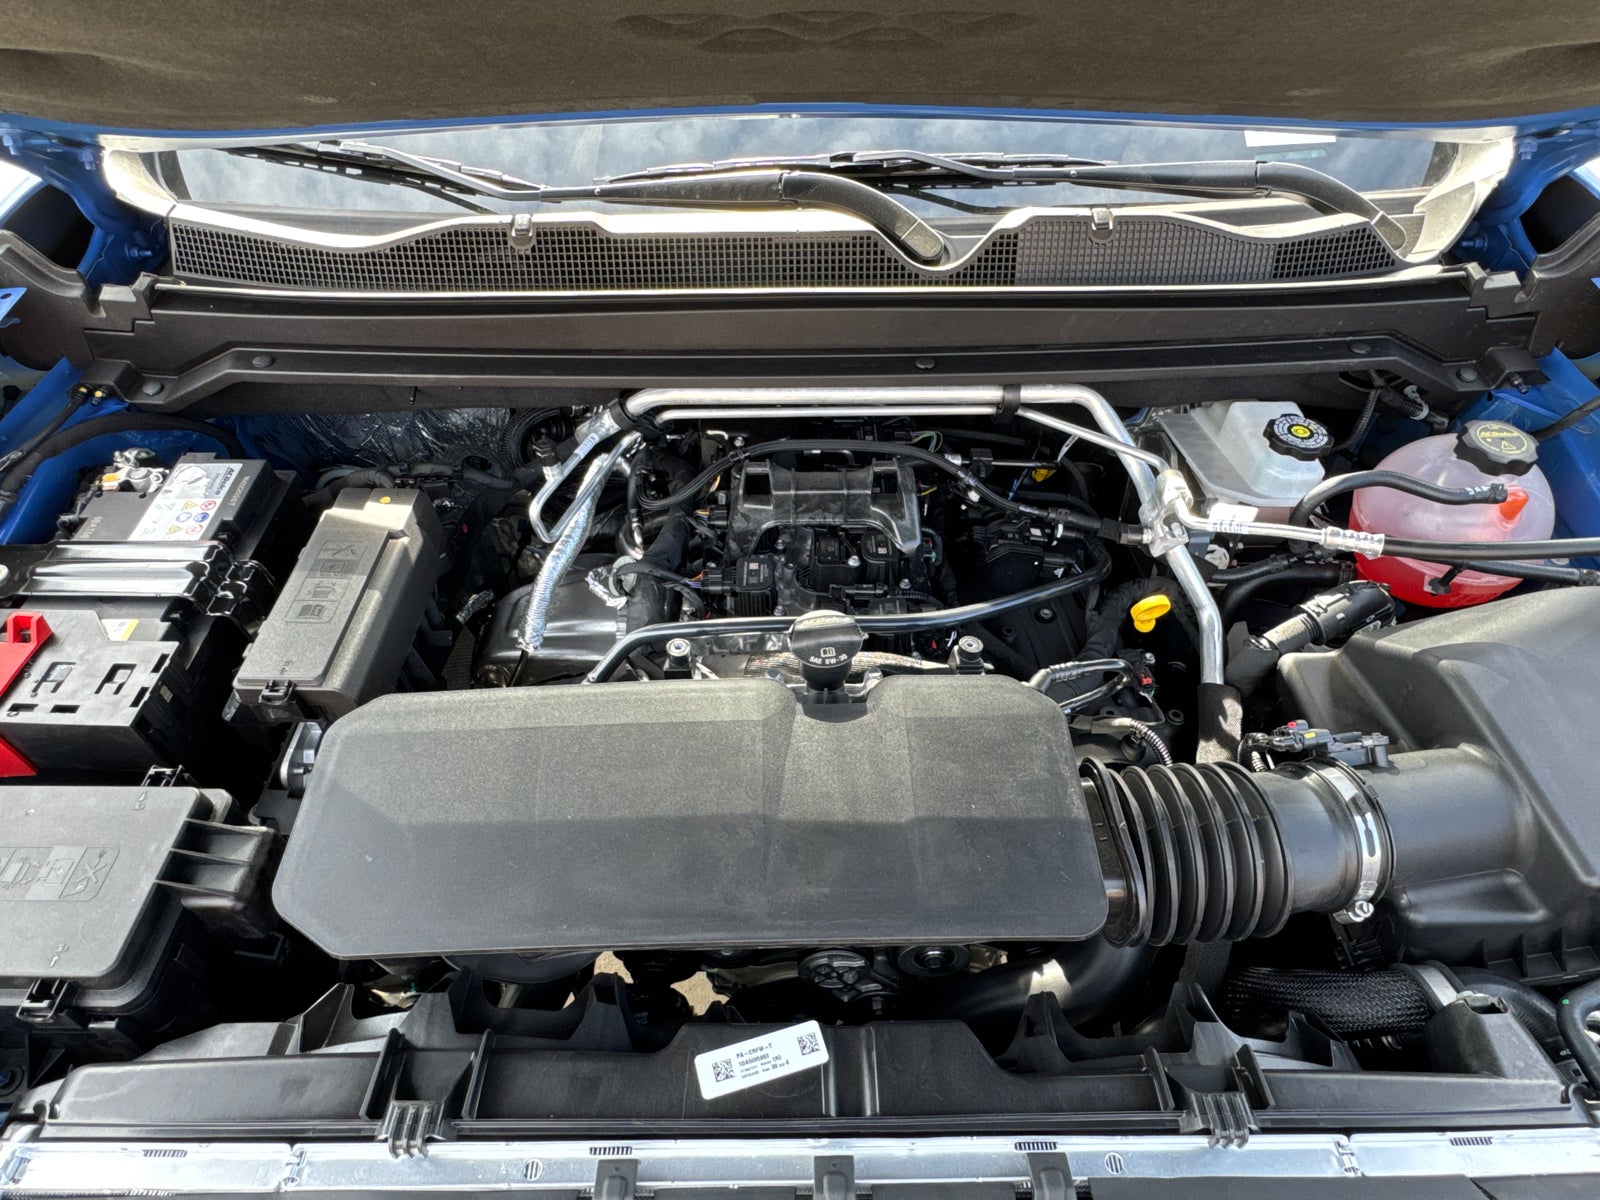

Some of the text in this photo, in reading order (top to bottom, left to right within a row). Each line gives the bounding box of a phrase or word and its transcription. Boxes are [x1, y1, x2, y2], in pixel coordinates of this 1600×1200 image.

[216, 467, 235, 495] ACDelco
[809, 653, 848, 665] SAE 5W-30
